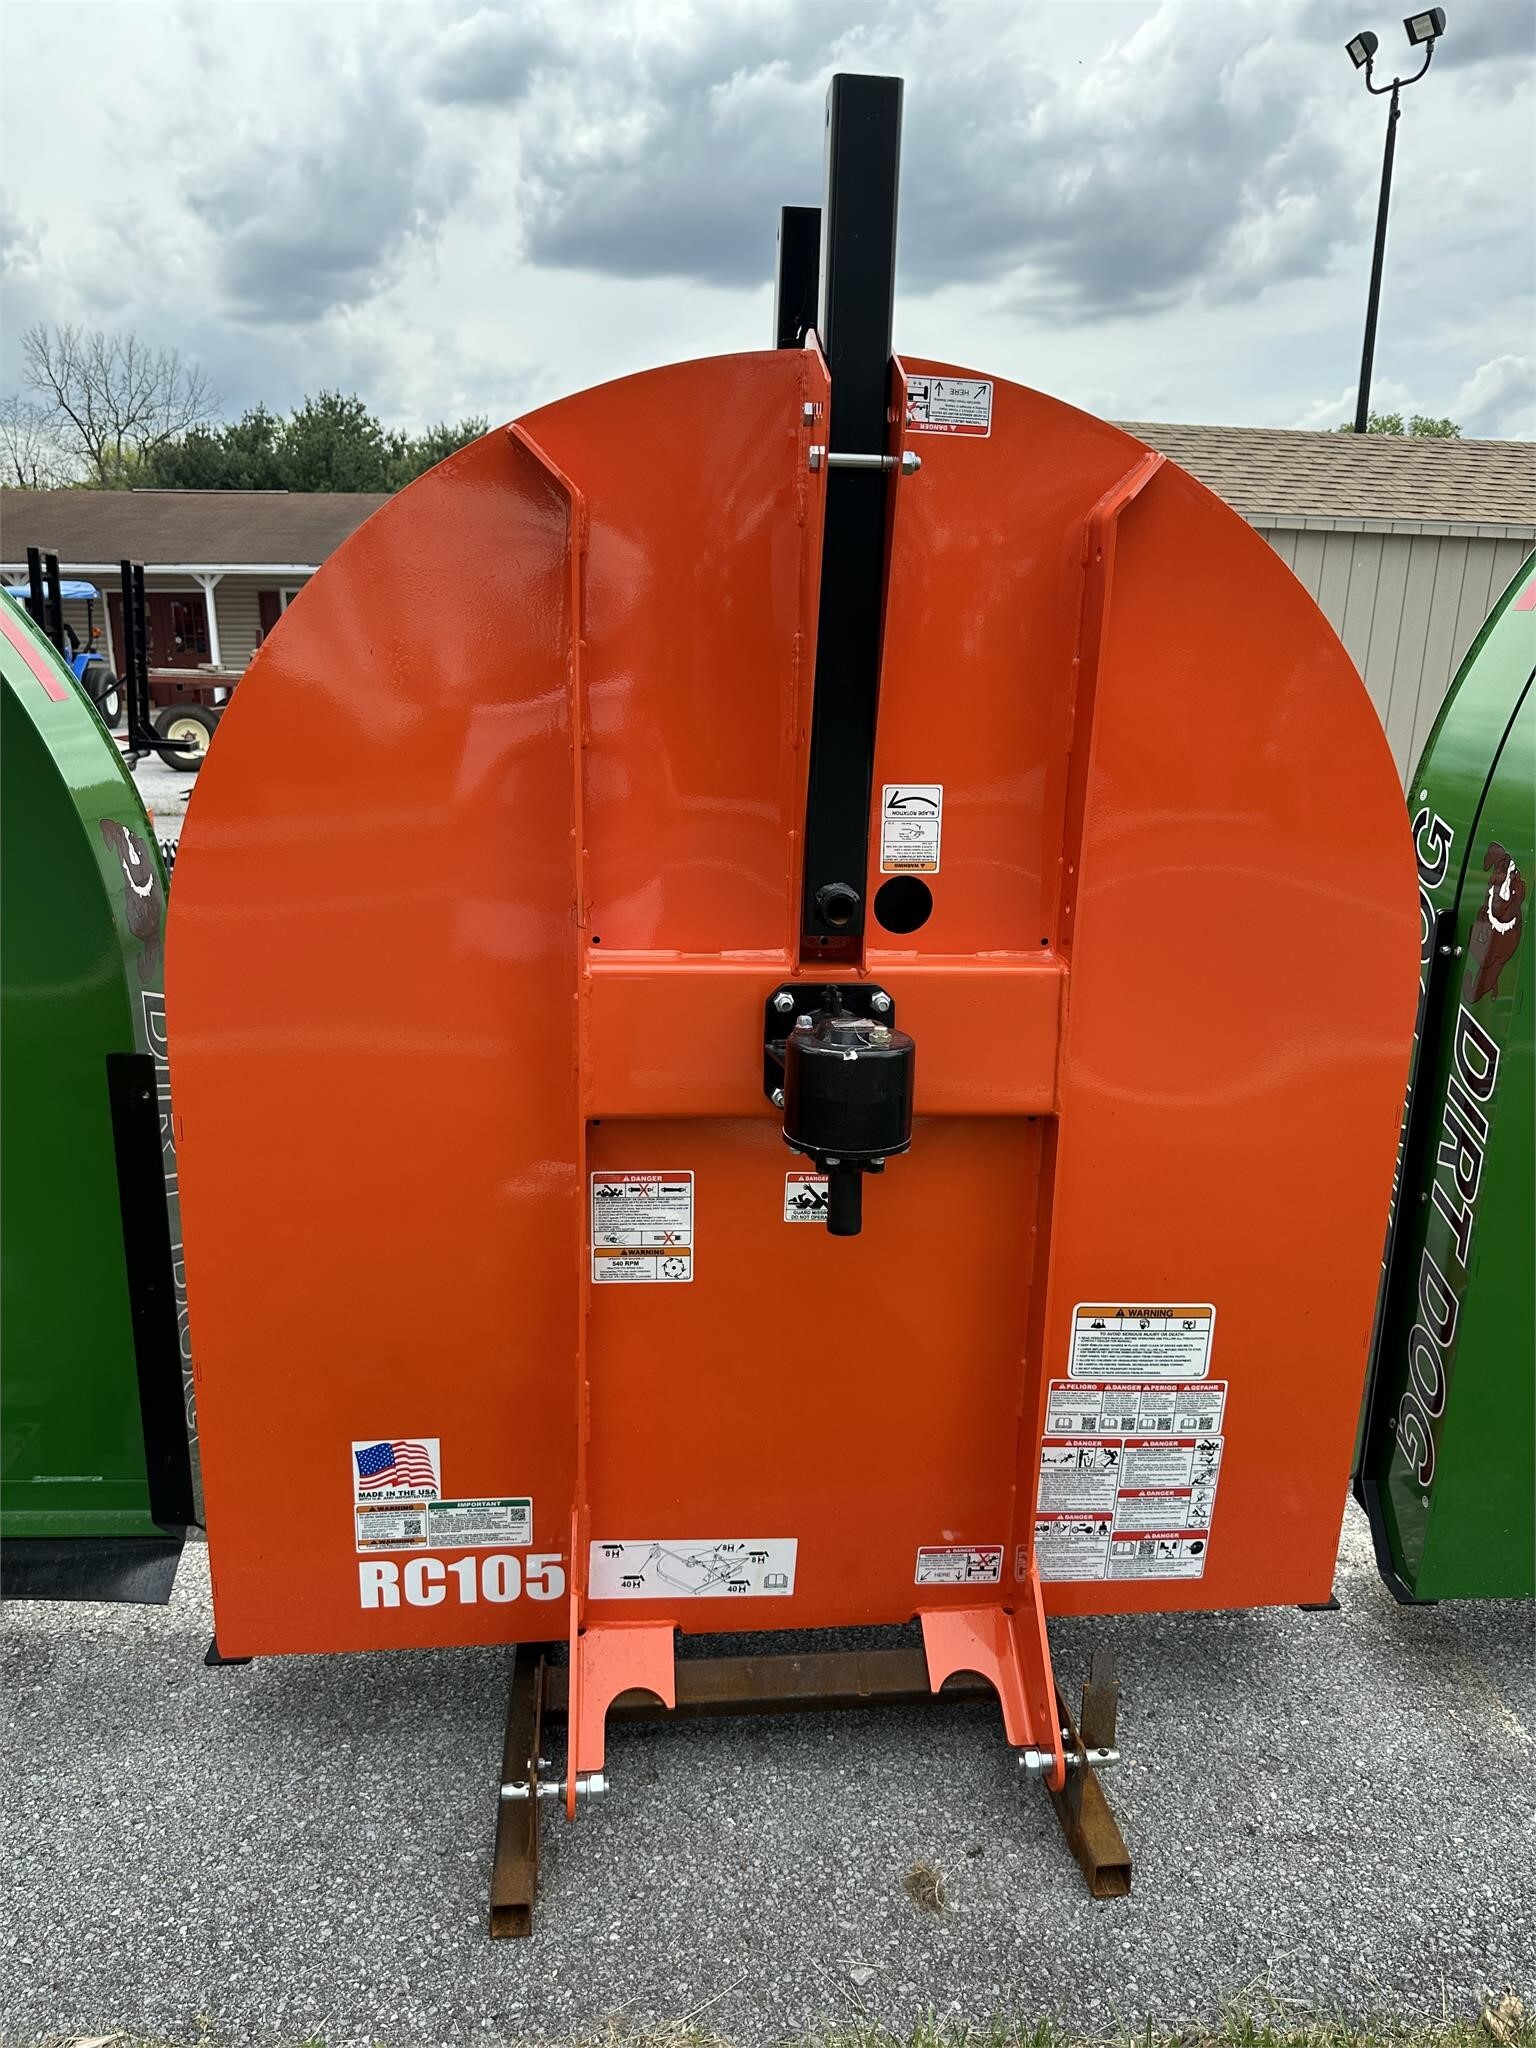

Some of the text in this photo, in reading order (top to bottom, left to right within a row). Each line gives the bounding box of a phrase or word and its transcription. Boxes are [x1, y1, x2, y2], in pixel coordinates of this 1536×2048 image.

[949, 388, 970, 396] HERE
[920, 423, 948, 431] DANGER
[1431, 1003, 1501, 1269] DIRT
[1128, 1309, 1174, 1317] WARNING
[1396, 1246, 1460, 1487] DOG
[358, 1553, 566, 1609] RC105
